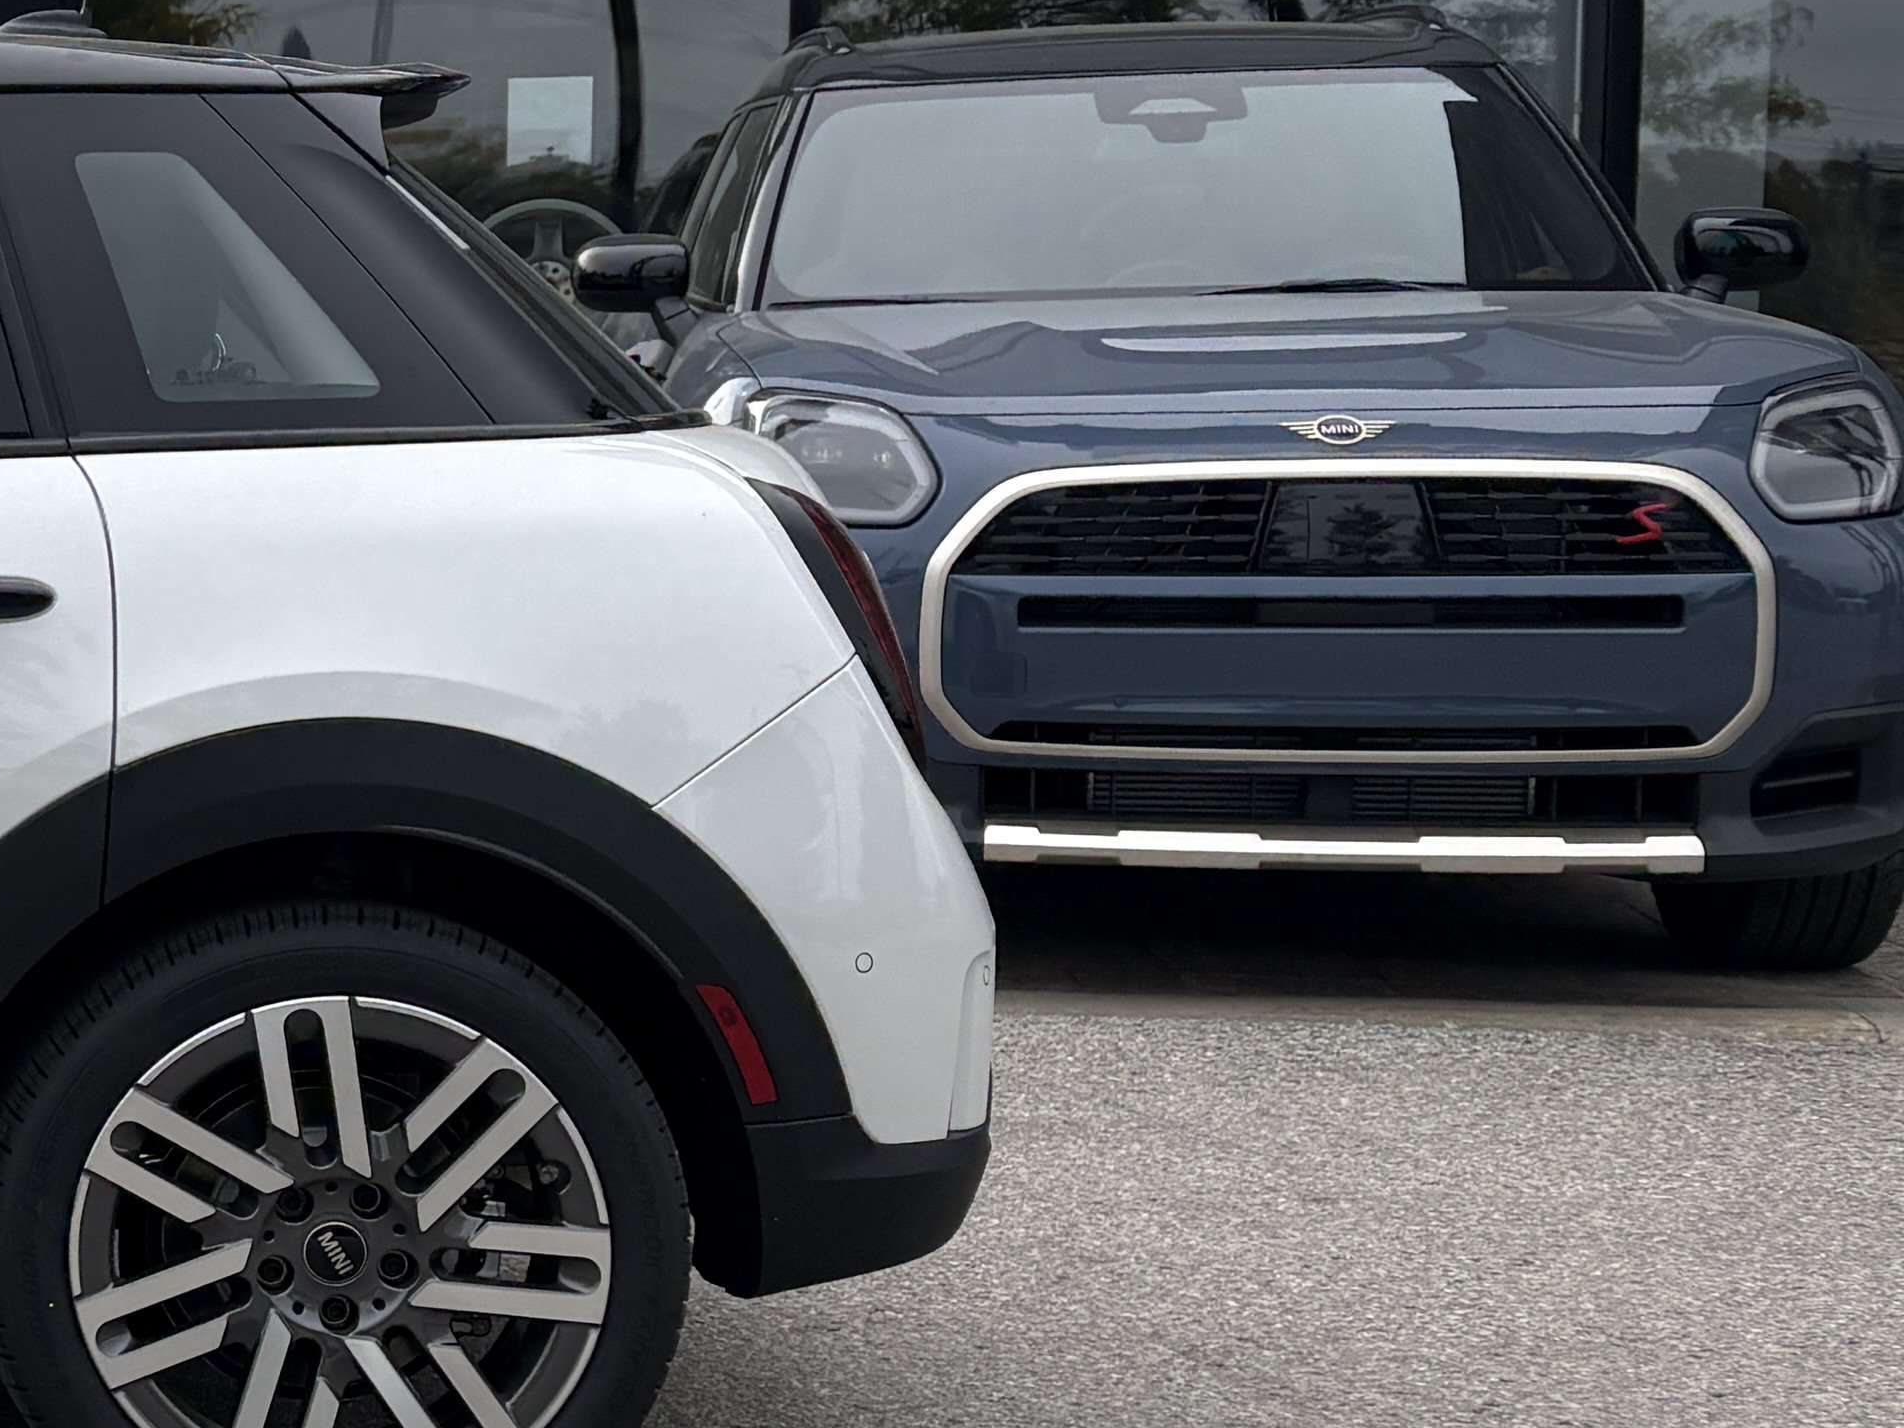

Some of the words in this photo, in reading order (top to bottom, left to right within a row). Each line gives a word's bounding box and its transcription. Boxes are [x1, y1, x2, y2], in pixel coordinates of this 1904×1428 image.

[1320, 424, 1360, 435] MINI
[1616, 503, 1667, 545] S
[317, 1231, 355, 1276] MINI
